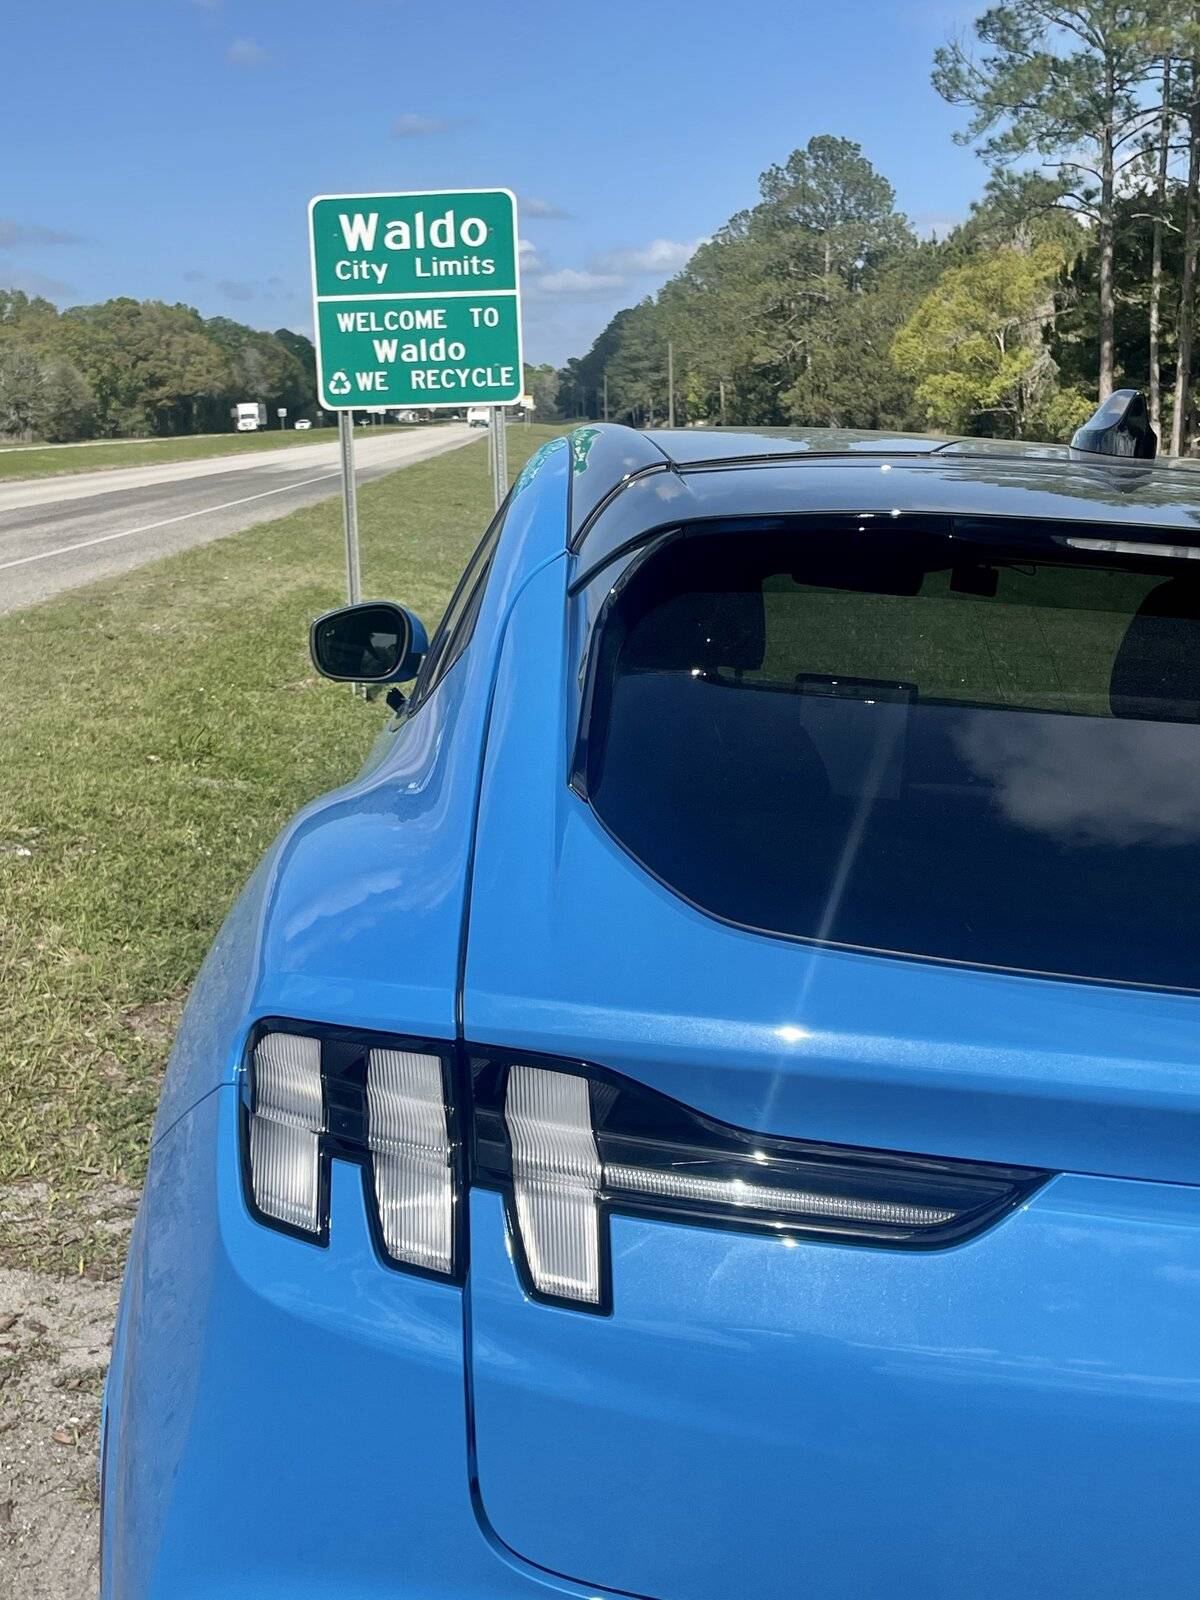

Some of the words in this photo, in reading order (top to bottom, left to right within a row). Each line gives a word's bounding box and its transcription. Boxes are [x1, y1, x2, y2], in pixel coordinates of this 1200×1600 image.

[338, 209, 488, 252] Waldo
[335, 260, 388, 284] City
[415, 255, 496, 277] Limits
[337, 309, 447, 333] WELCOME
[469, 307, 499, 328] TO
[372, 337, 466, 364] Waldo
[355, 371, 389, 391] WE
[411, 366, 515, 390] RECYCLE
